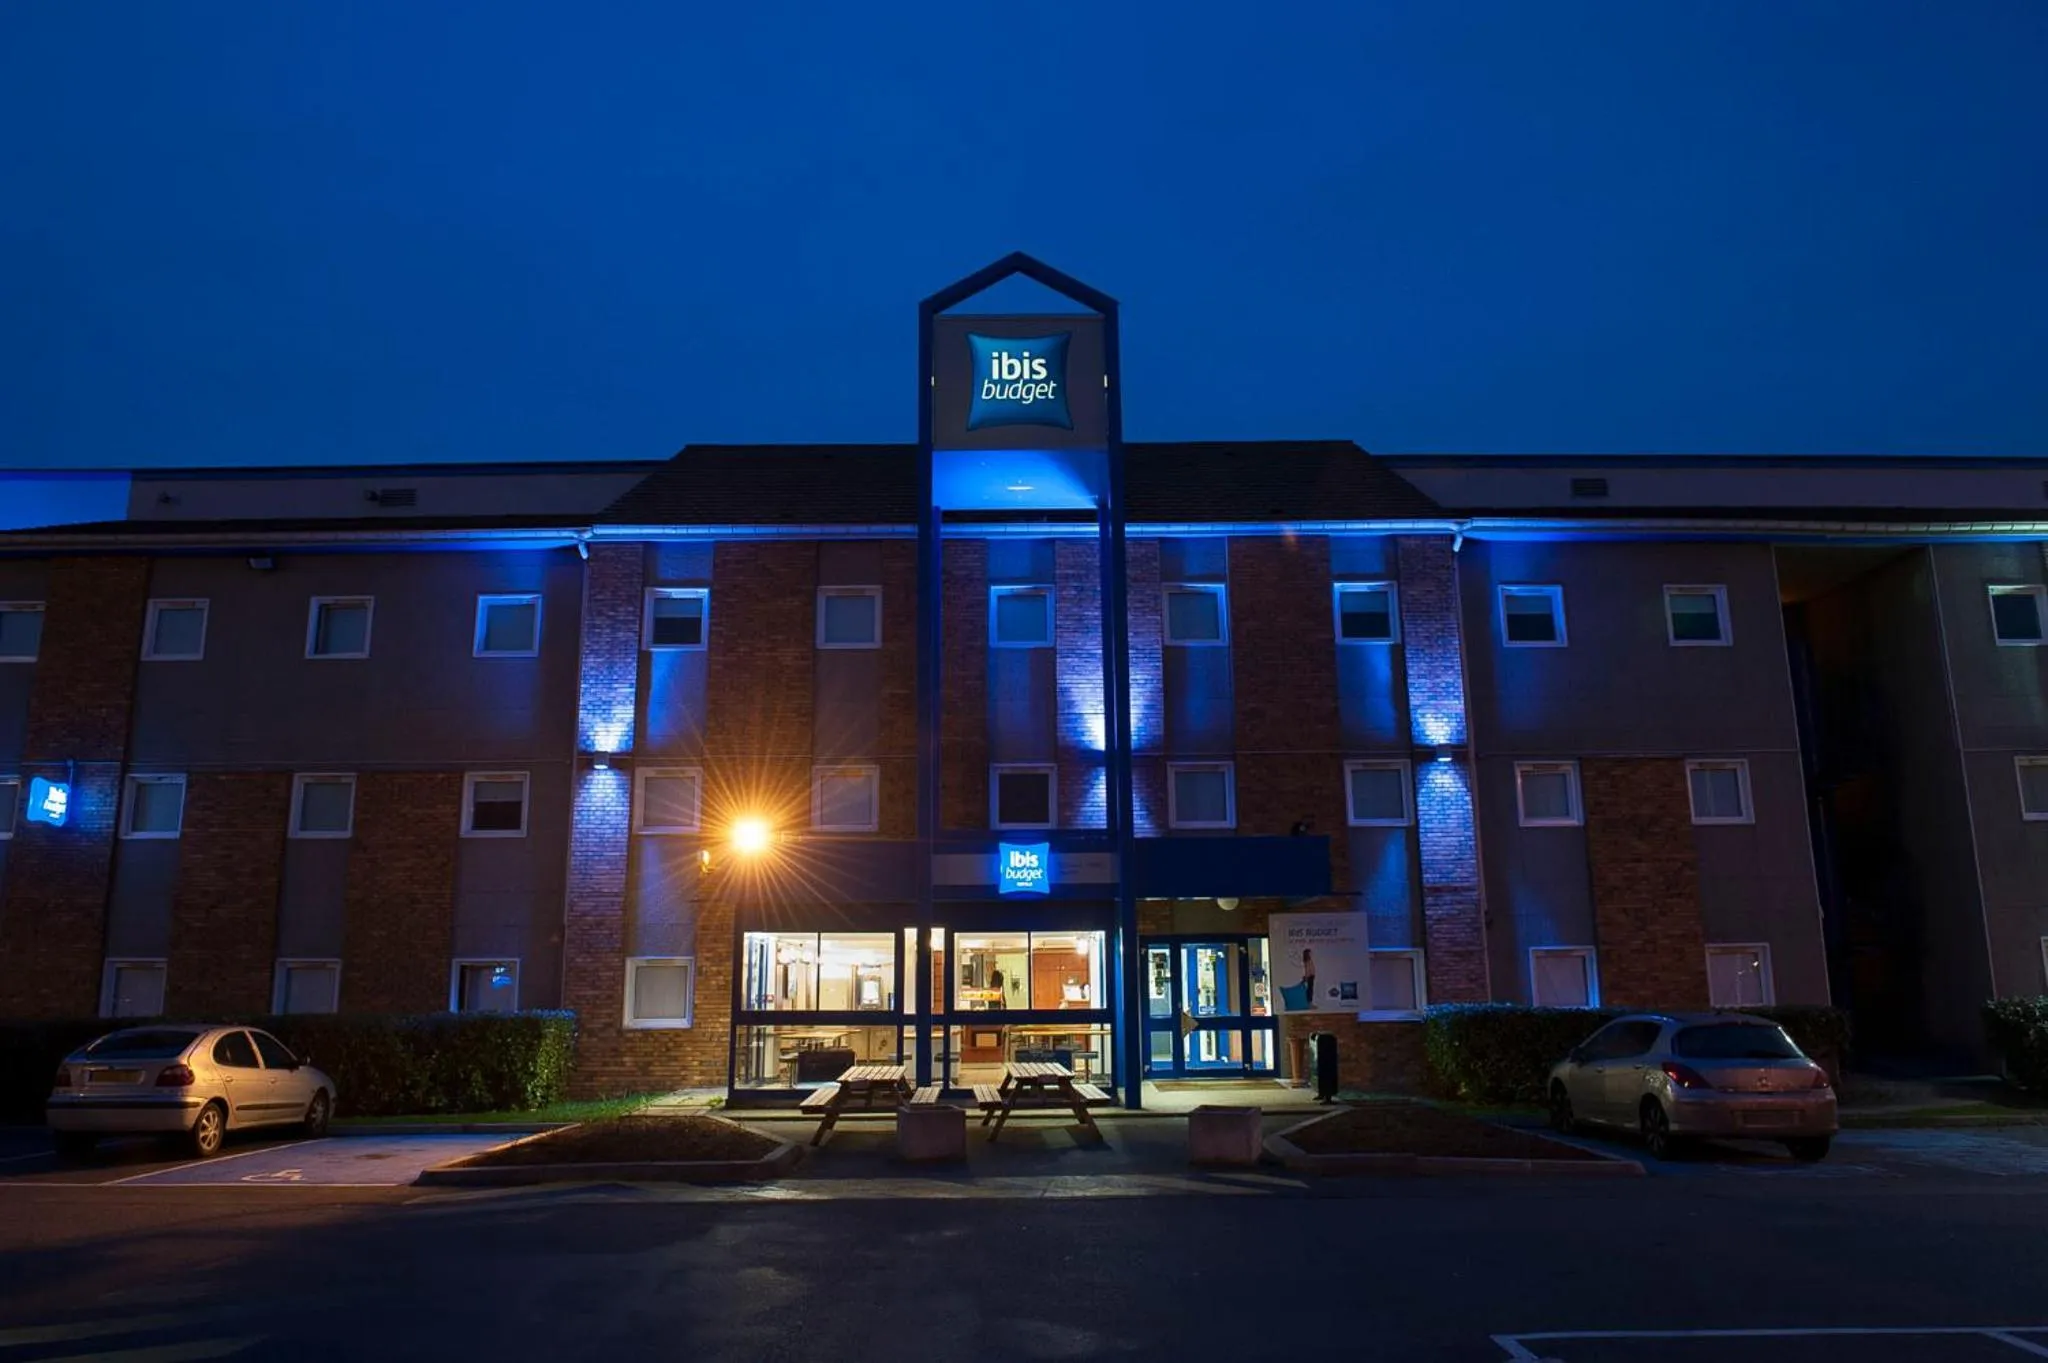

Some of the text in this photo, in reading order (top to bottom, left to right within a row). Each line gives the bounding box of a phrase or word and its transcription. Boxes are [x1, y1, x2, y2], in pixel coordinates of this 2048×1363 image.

[992, 352, 1048, 380] ibis
[981, 379, 1057, 404] budget
[1010, 850, 1039, 867] ibis
[1005, 867, 1043, 881] budget
